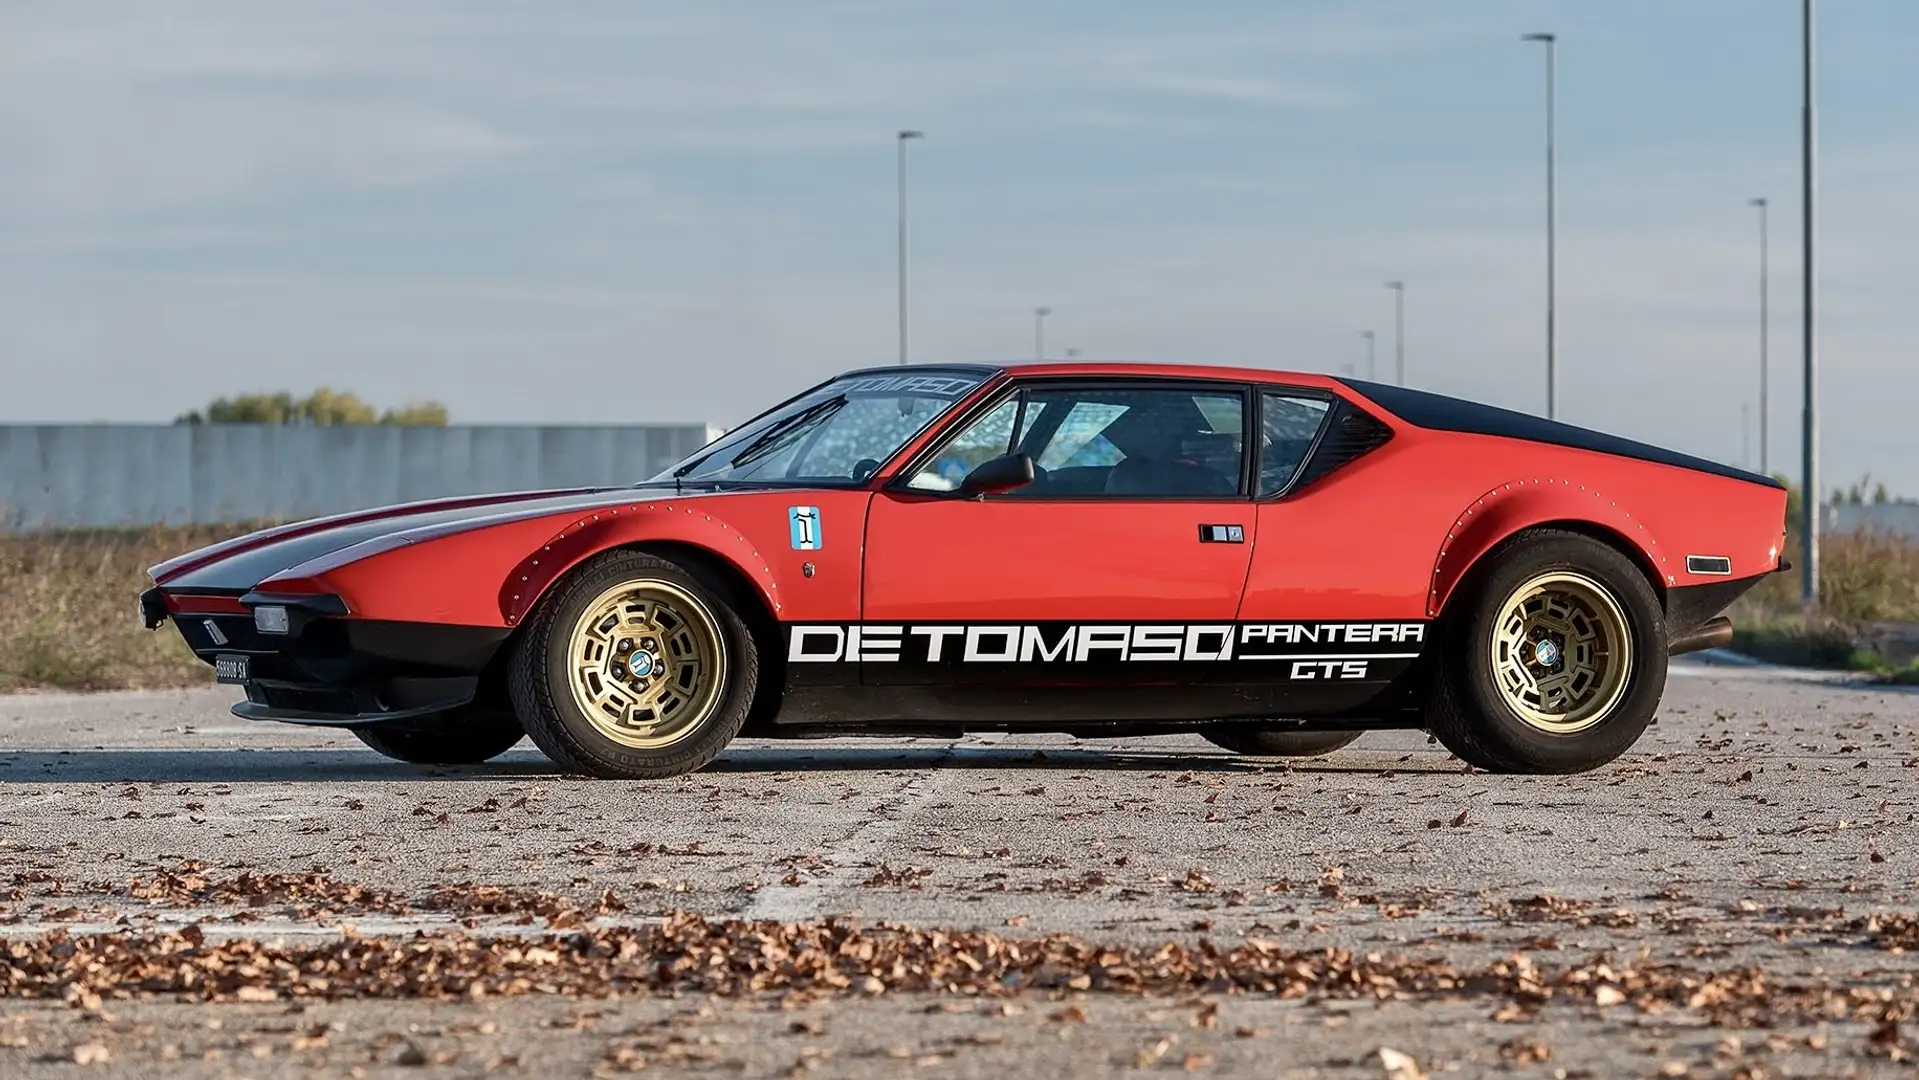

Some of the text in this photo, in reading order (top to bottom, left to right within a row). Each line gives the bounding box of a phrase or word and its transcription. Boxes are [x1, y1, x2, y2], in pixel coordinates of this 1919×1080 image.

[608, 559, 674, 577] CINTURATO
[1241, 624, 1425, 644] PANTERA
[1290, 661, 1368, 680] GTS
